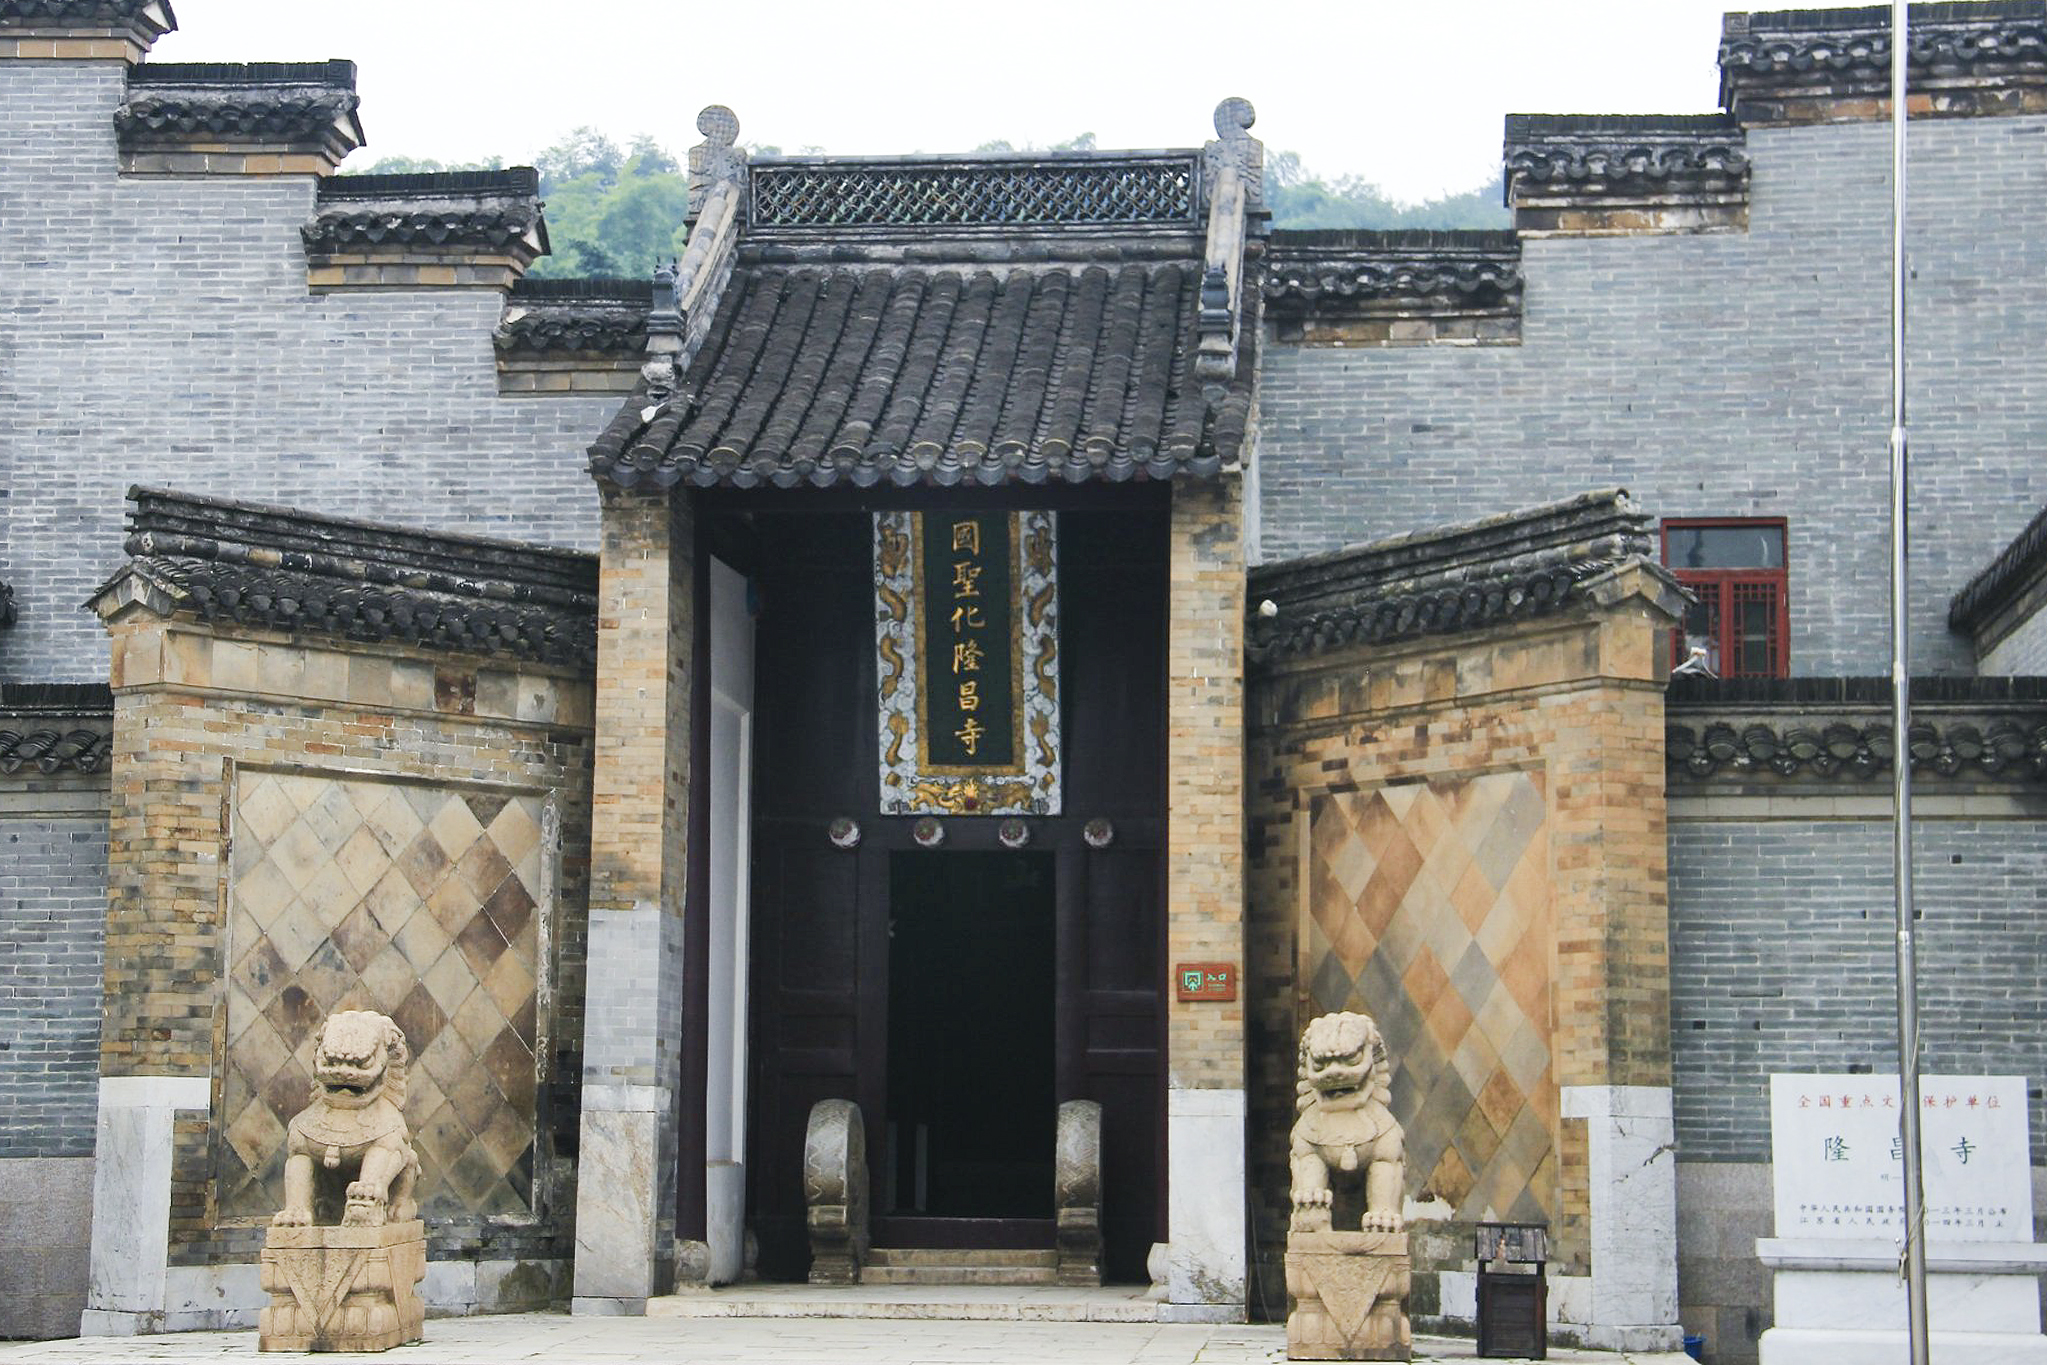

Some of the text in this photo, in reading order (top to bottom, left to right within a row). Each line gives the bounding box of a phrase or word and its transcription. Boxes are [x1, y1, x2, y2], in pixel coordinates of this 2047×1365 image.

[1799, 1094, 2002, 1109] 全国重点文保护单位
